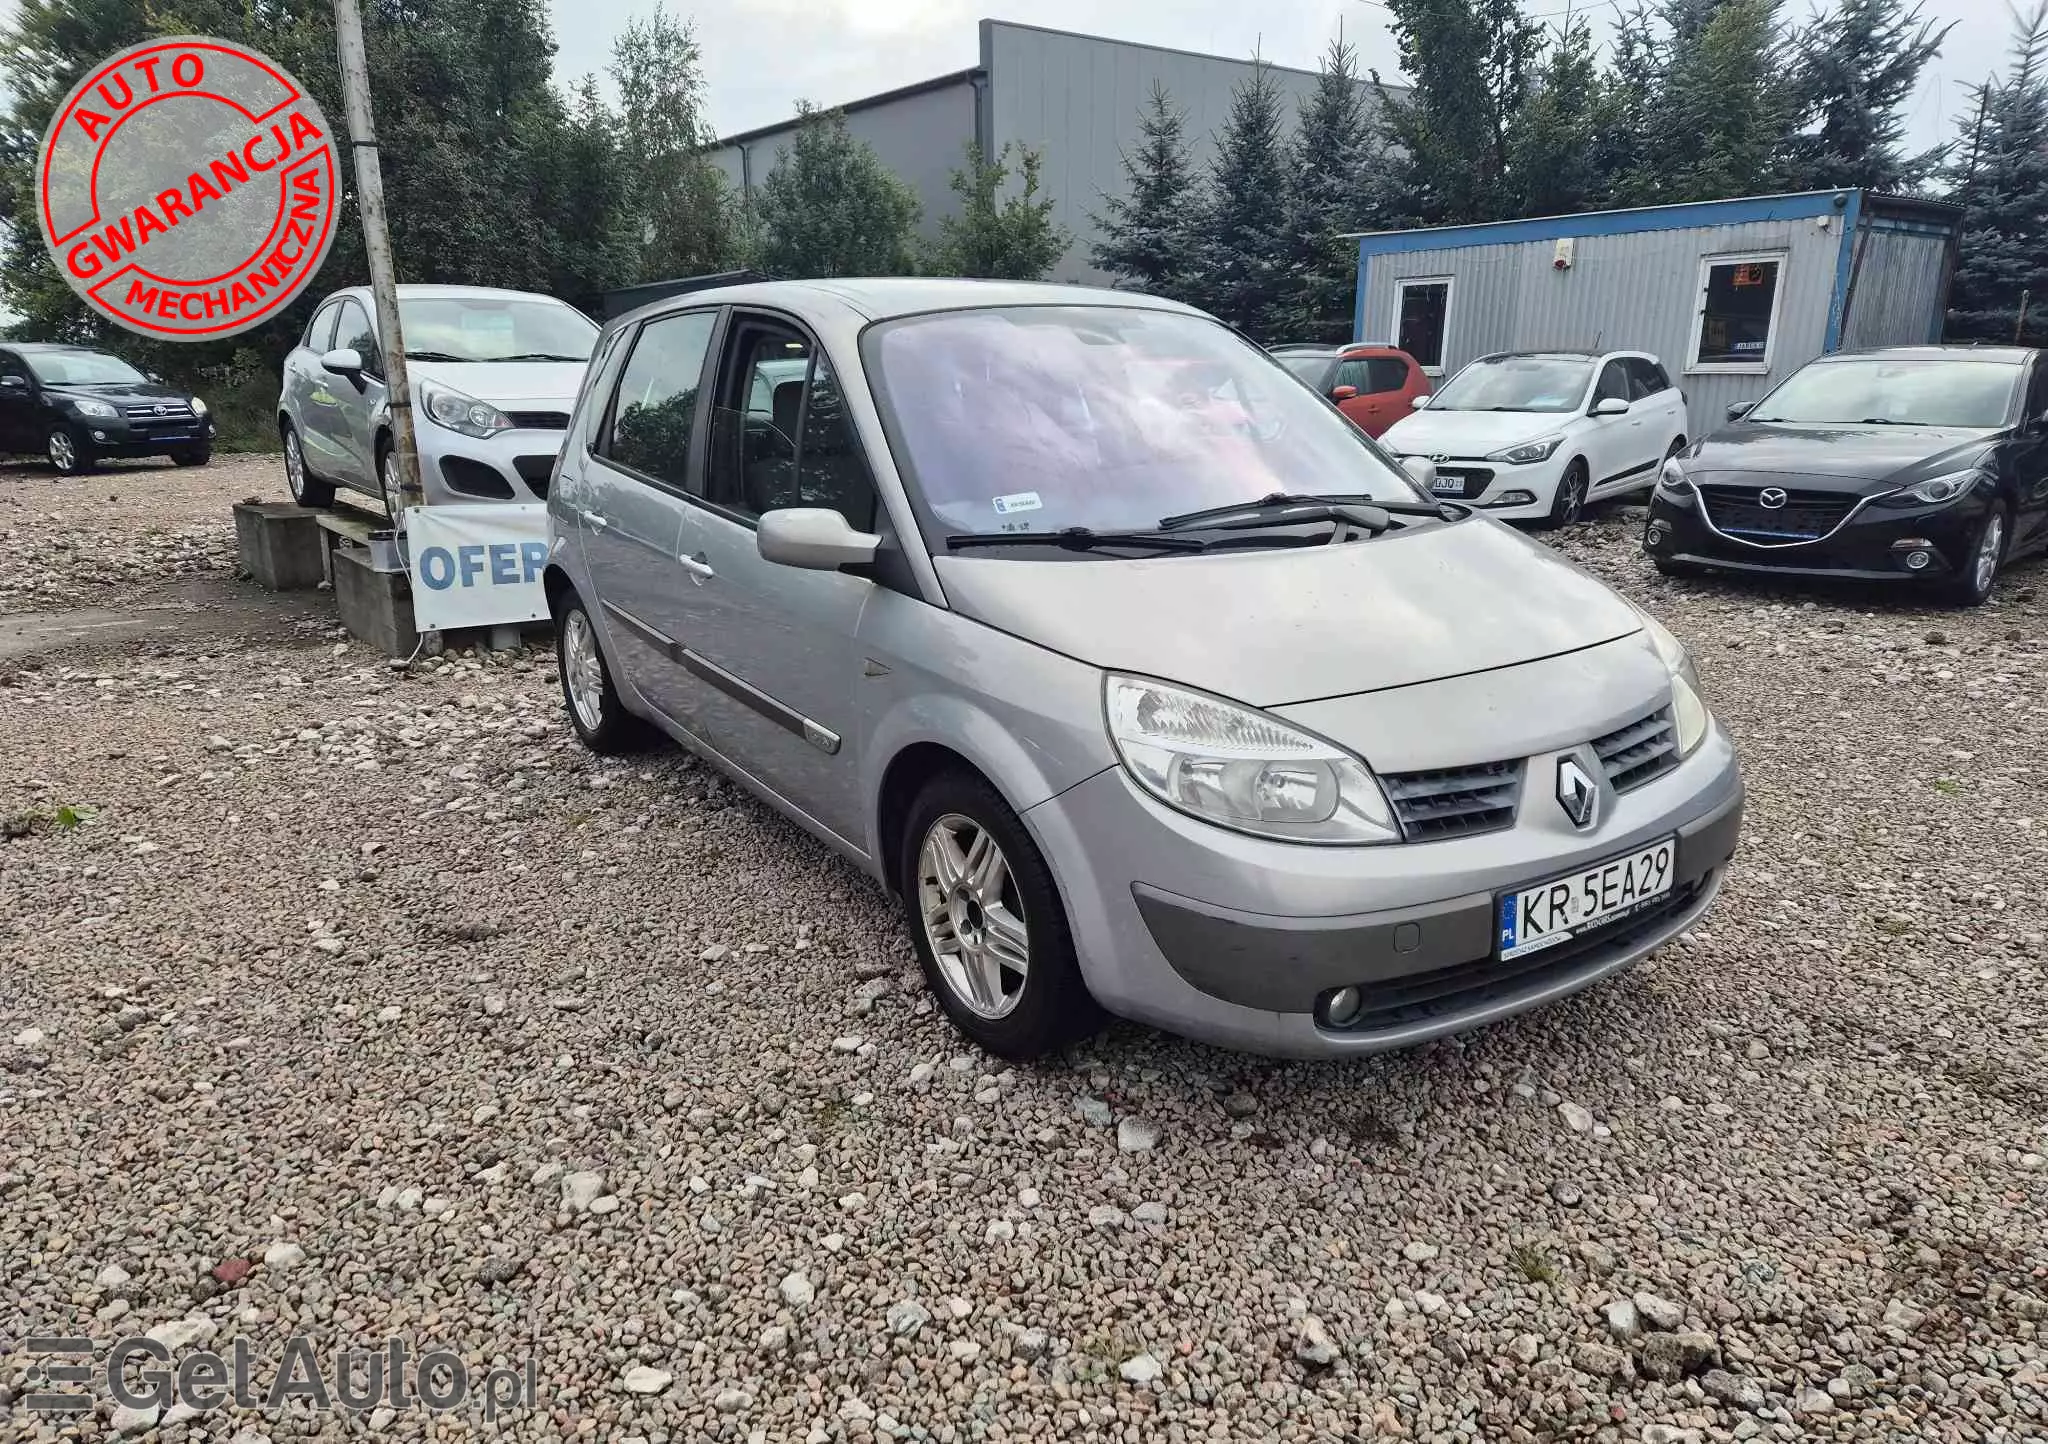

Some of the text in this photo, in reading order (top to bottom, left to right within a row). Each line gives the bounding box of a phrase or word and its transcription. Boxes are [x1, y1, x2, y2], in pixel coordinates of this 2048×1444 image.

[1523, 883, 1570, 939] KR
[1583, 847, 1669, 917] 5EA29
[1502, 927, 1514, 942] PL
